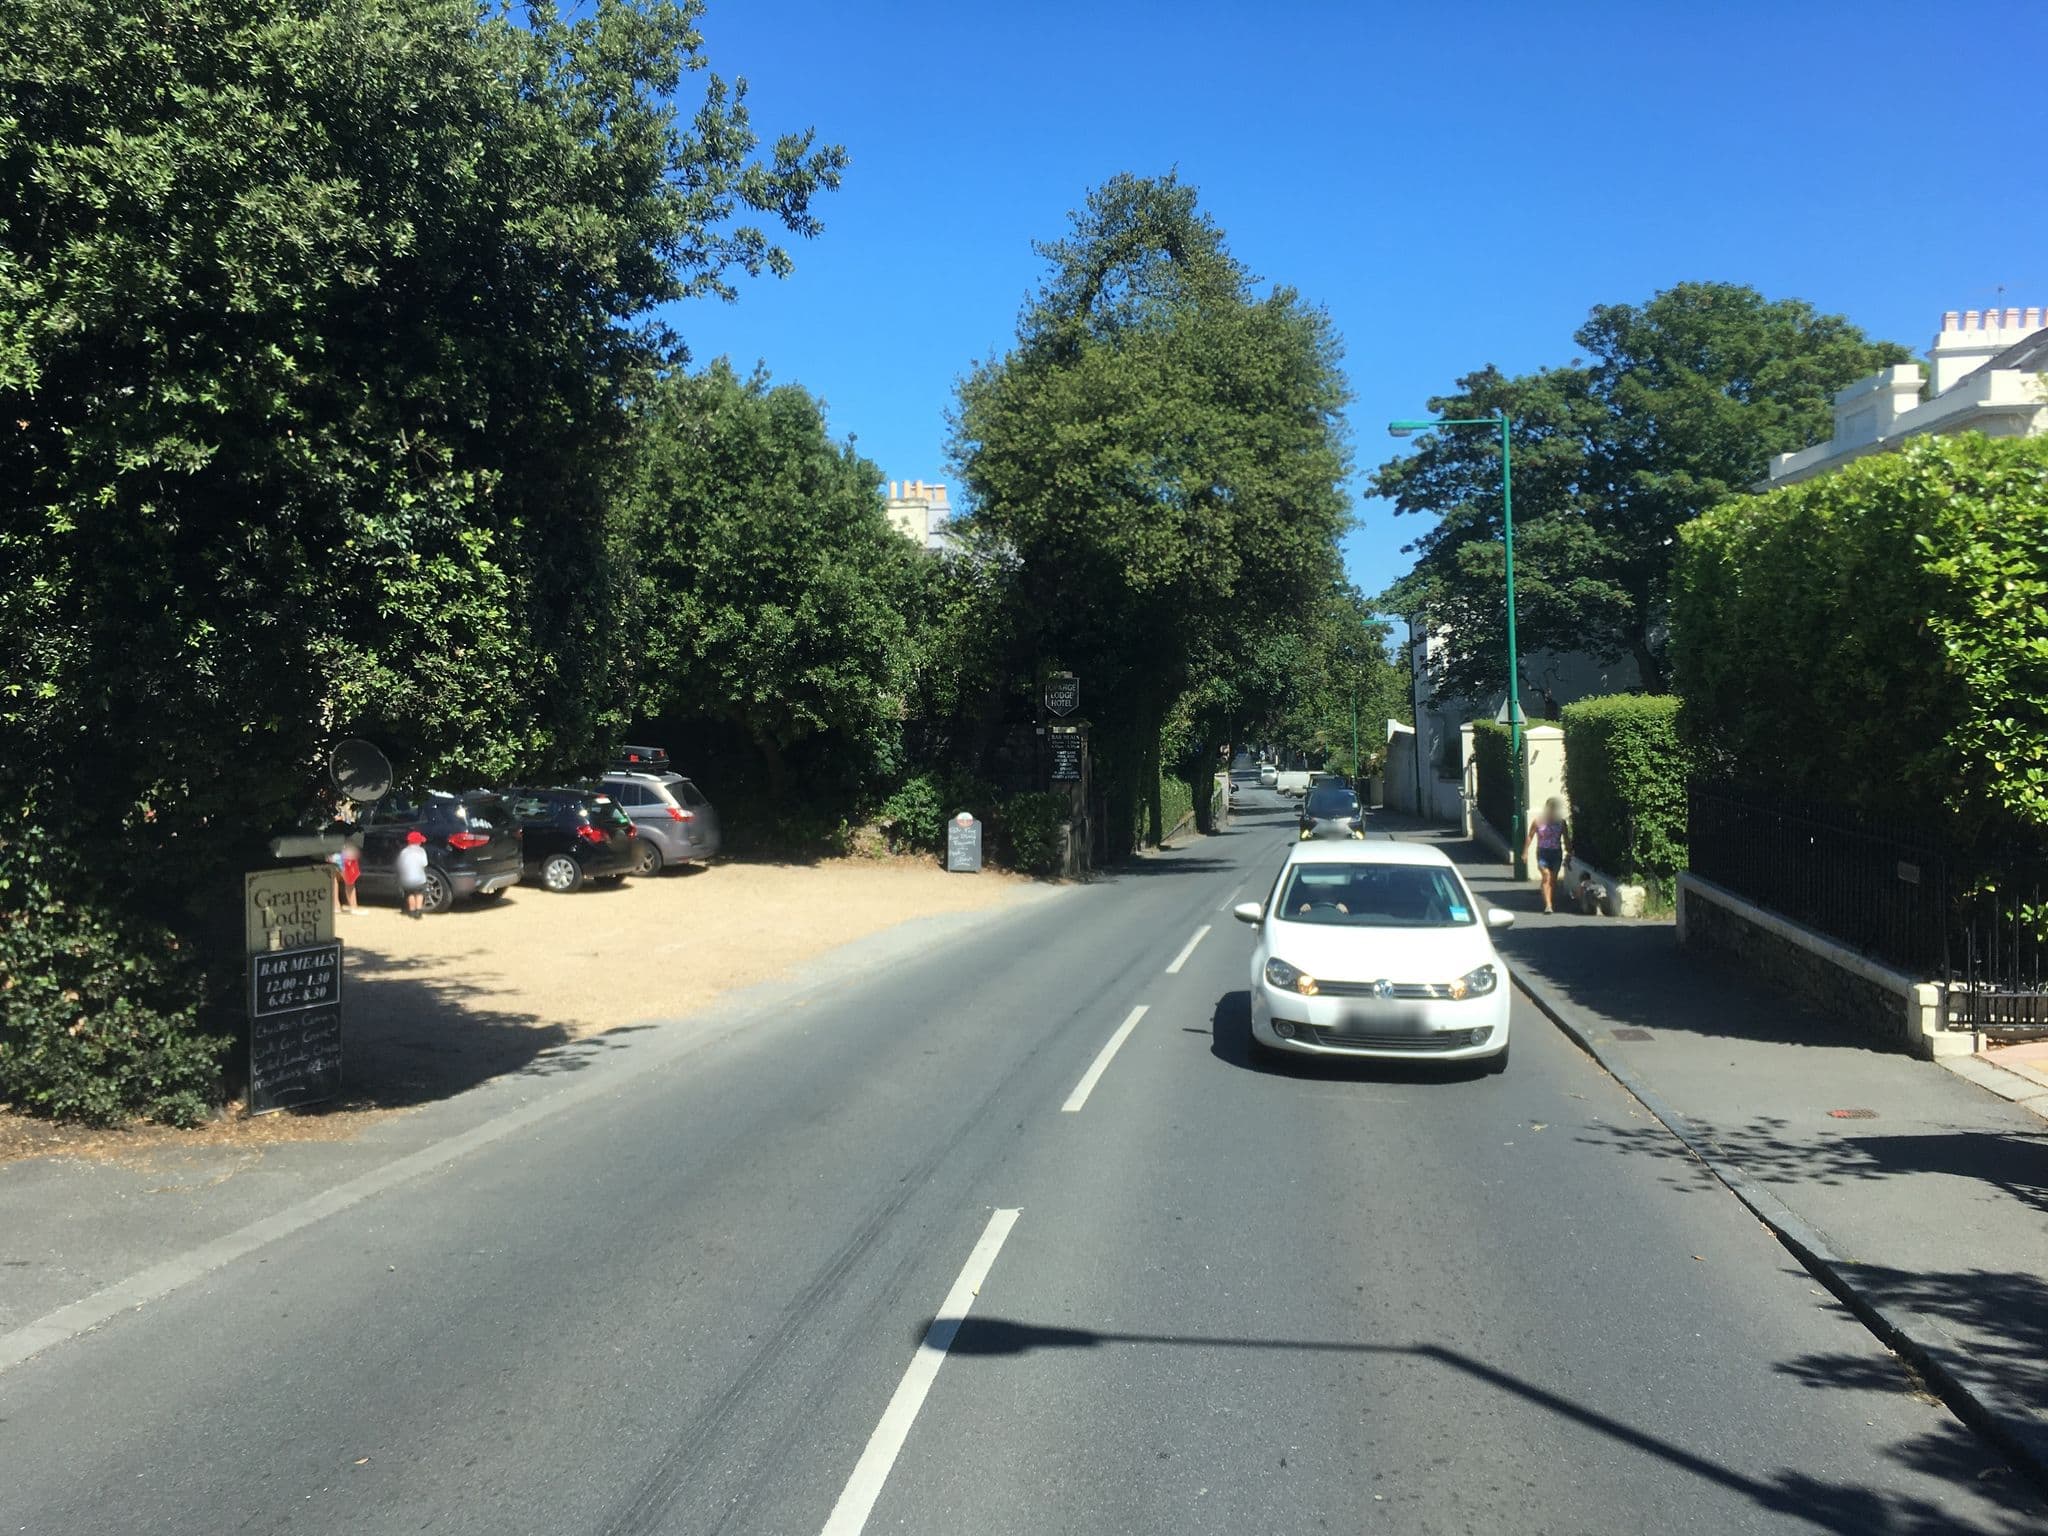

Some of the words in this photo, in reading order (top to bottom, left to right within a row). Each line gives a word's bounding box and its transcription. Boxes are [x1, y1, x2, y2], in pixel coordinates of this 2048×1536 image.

[1050, 691, 1073, 699] LODGE
[1051, 699, 1073, 707] HOTEL
[254, 887, 327, 909] Grange
[261, 903, 321, 930] Lodge
[265, 923, 318, 950] Hotel
[261, 960, 288, 977] BAR
[290, 953, 337, 972] MEALS
[267, 977, 297, 993] 12.00
[307, 971, 330, 986] 1.30
